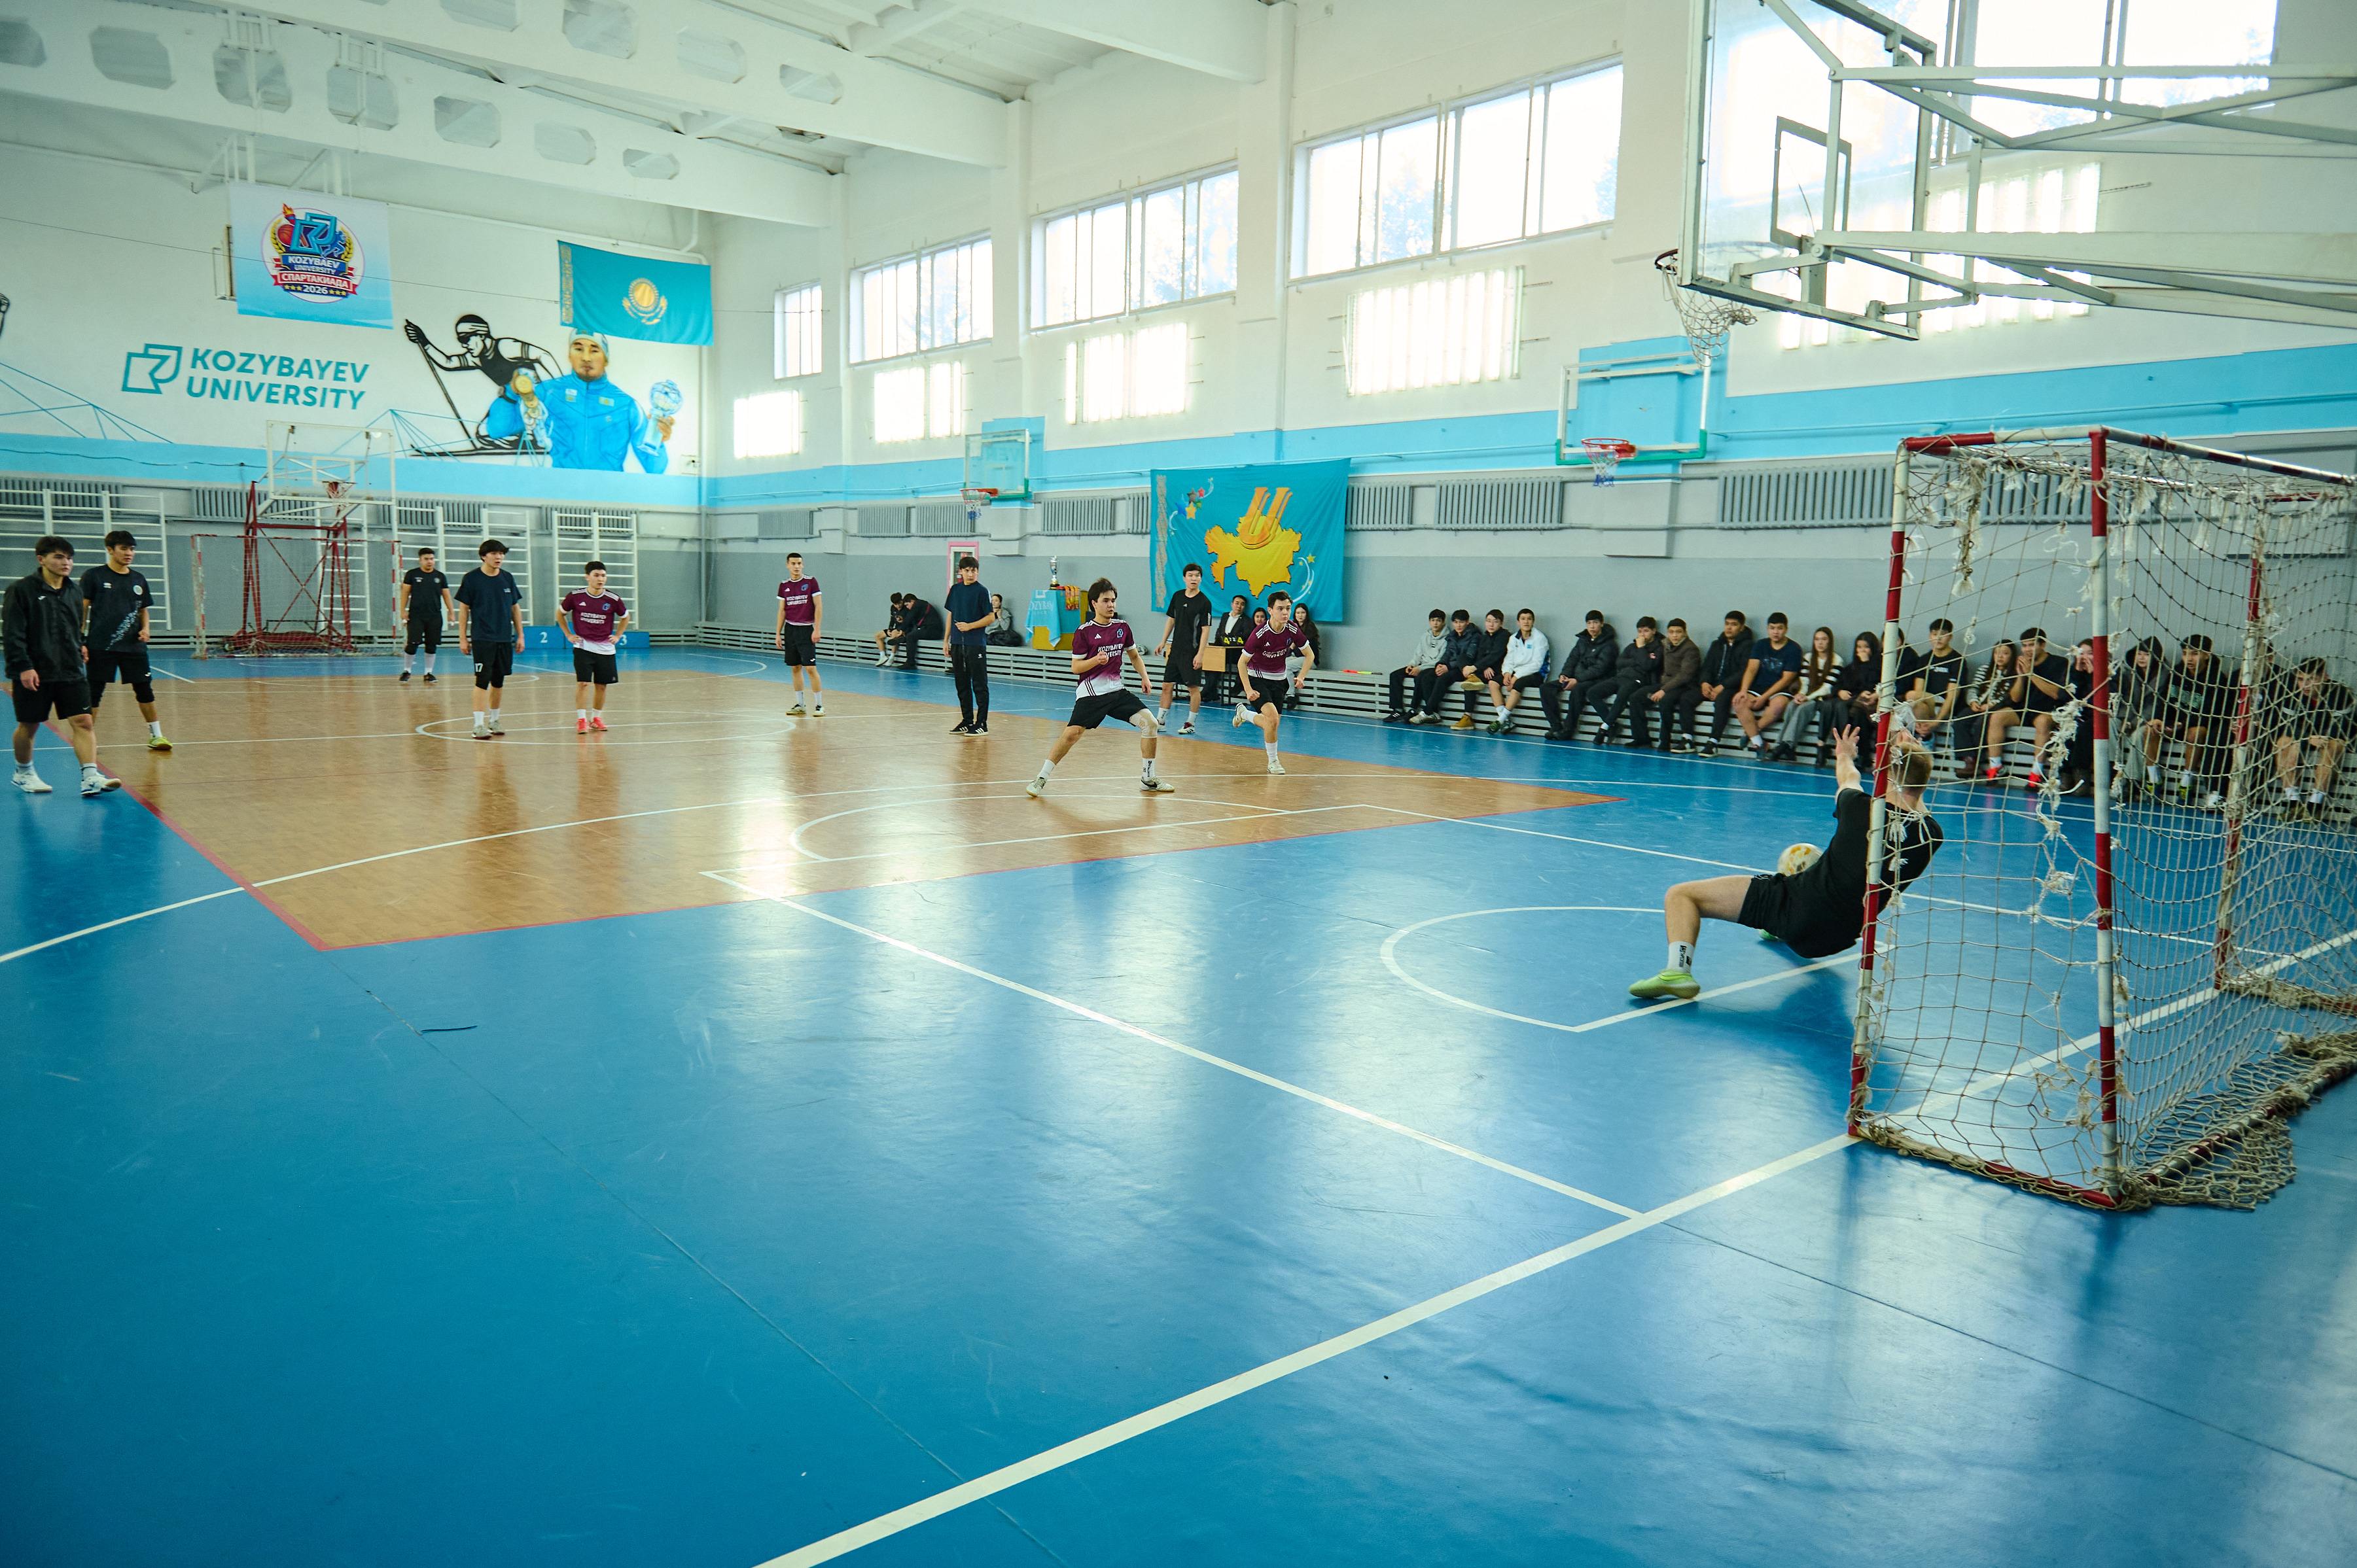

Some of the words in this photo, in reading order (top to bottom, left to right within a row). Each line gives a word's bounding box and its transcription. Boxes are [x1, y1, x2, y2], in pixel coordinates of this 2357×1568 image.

[288, 256, 340, 269] KOZYBAEV
[294, 264, 336, 275] UNIVERSITY
[281, 273, 349, 288] СПАРТАКИАДА
[302, 285, 328, 294] 2026
[190, 347, 370, 383] KOZYBAYEV
[186, 375, 366, 410] UNIVERSITY
[540, 631, 548, 644] 2
[619, 634, 628, 646] 3
[474, 663, 484, 672] 17
